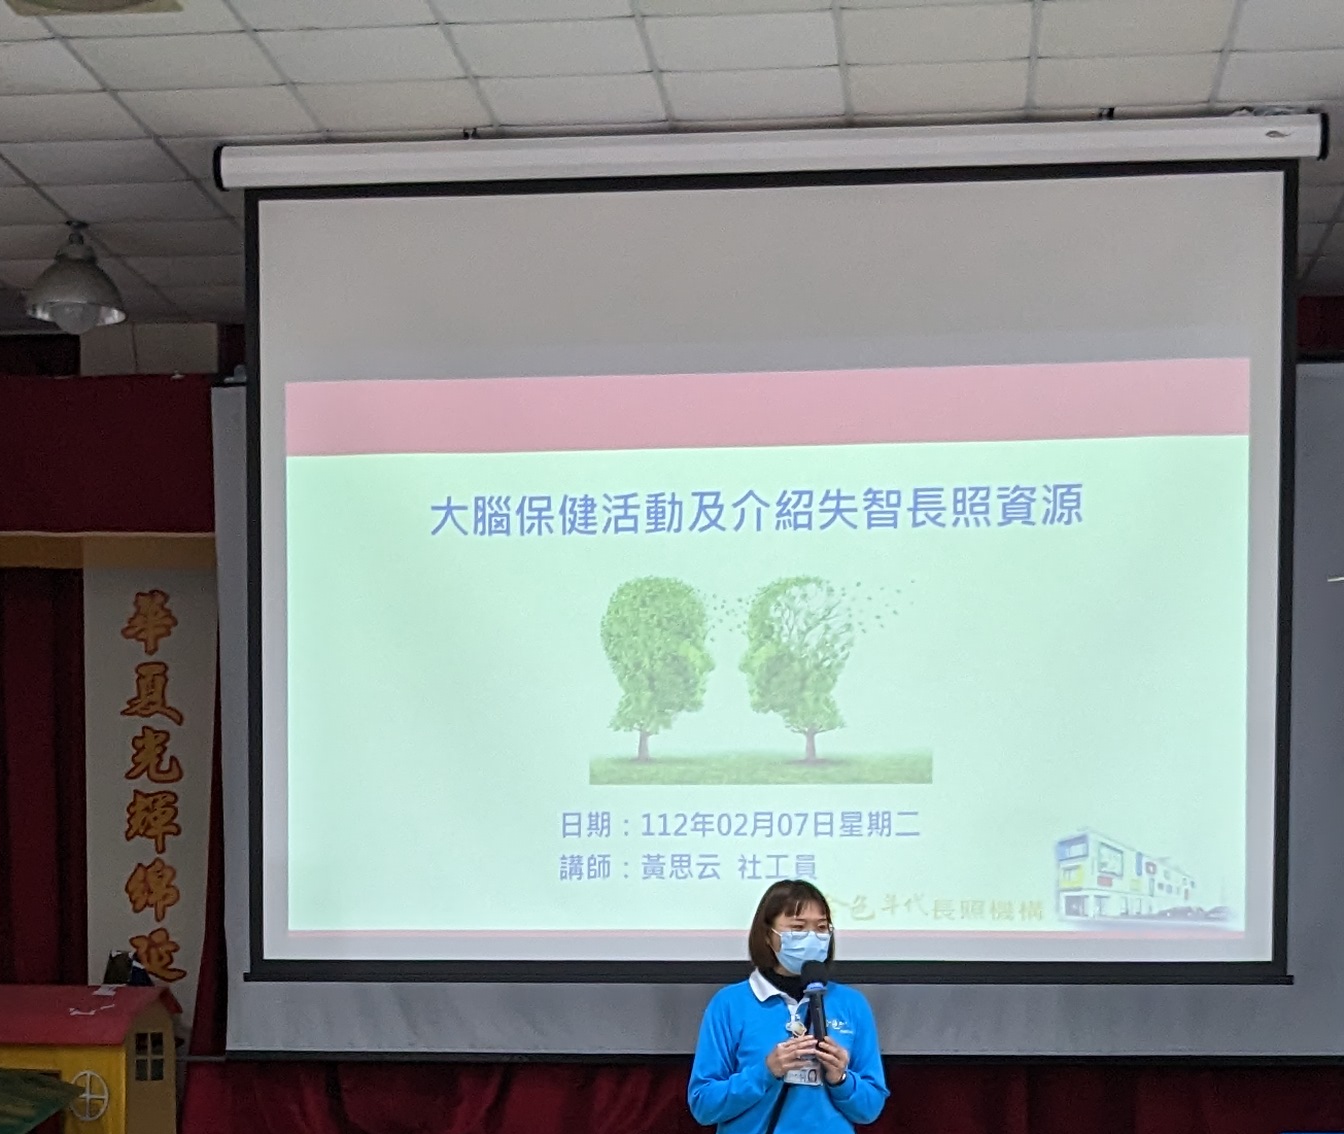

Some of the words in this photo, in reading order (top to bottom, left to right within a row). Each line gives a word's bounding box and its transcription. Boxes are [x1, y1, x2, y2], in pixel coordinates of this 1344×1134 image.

[430, 482, 1085, 537] 大腦保健活動及介紹失智長照資源
[737, 854, 818, 881] 社工員
